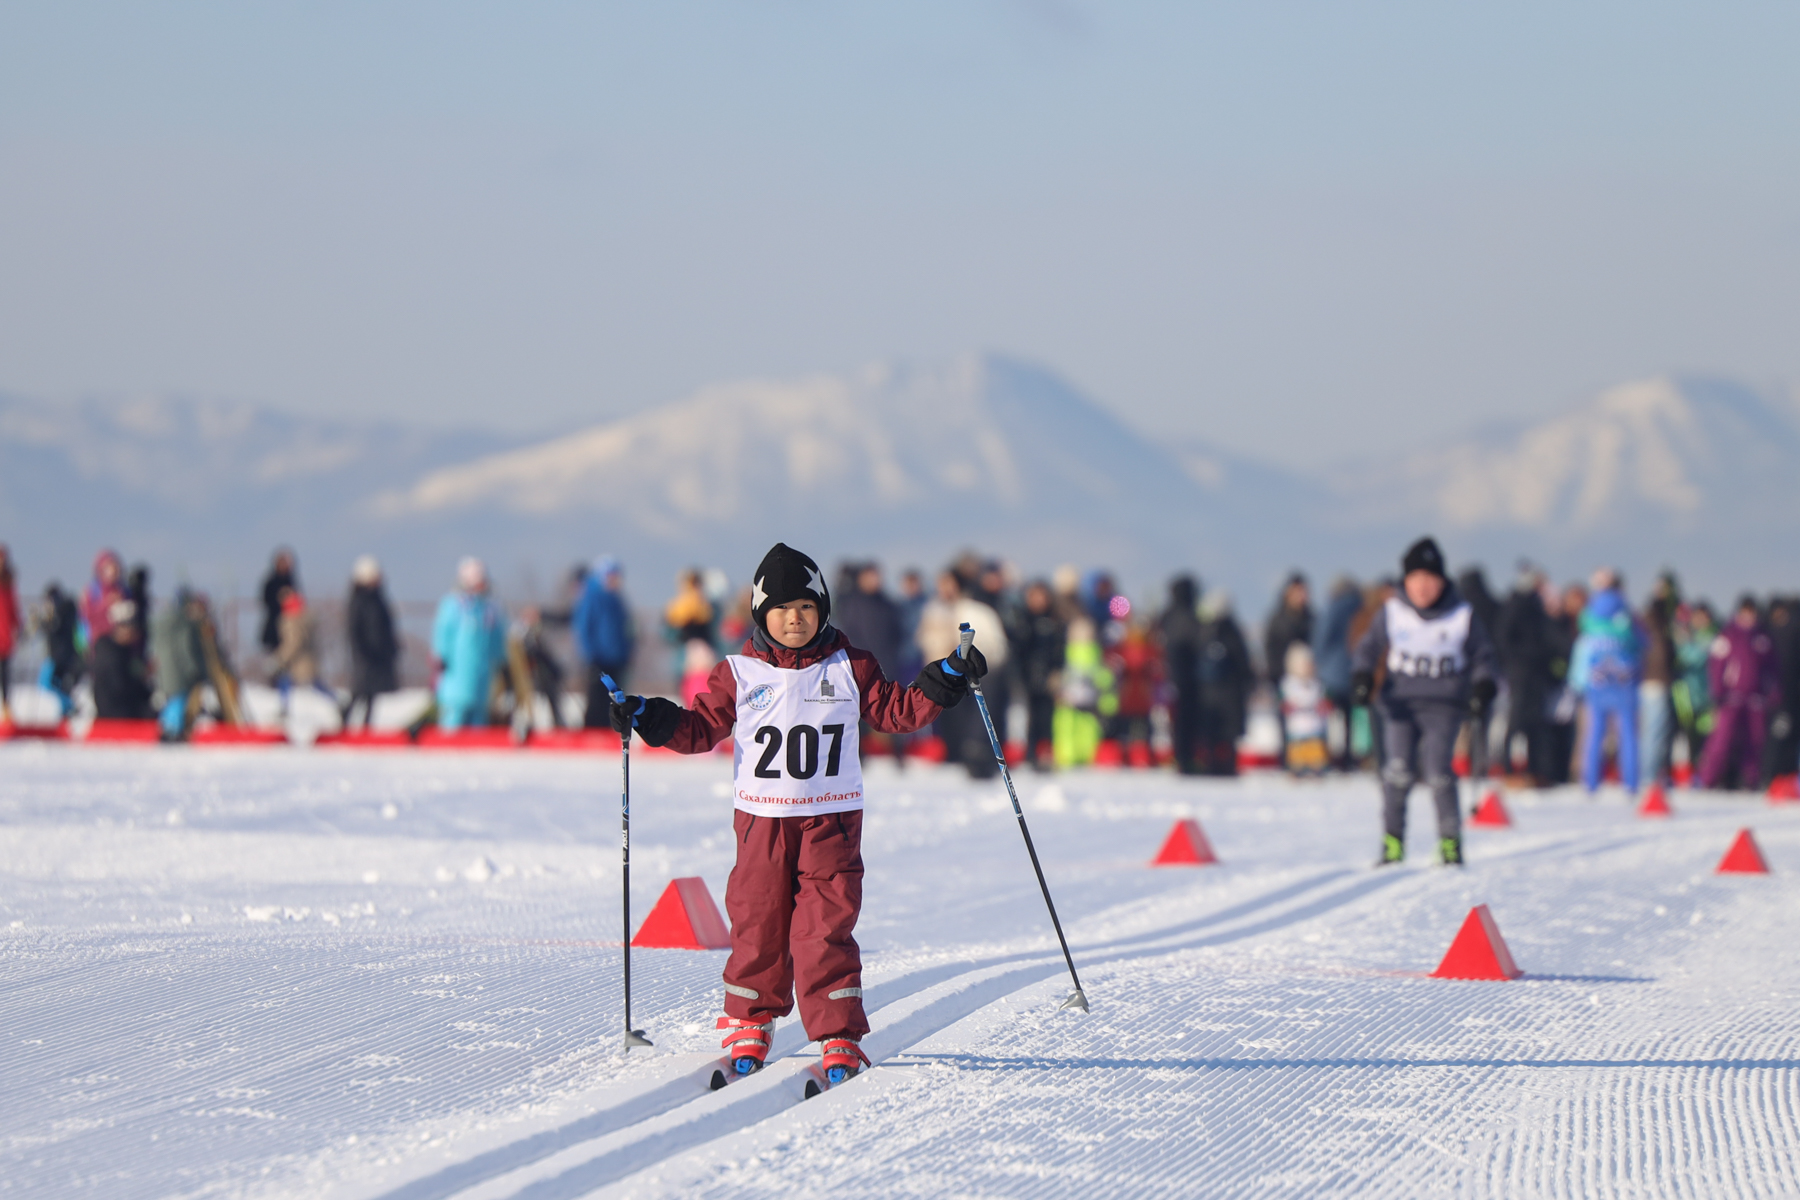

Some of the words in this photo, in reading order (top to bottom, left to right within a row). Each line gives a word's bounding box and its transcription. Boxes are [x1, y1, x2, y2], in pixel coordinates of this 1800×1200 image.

[754, 724, 845, 780] 207
[739, 790, 813, 805] Сахалинская
[816, 790, 861, 804] область
